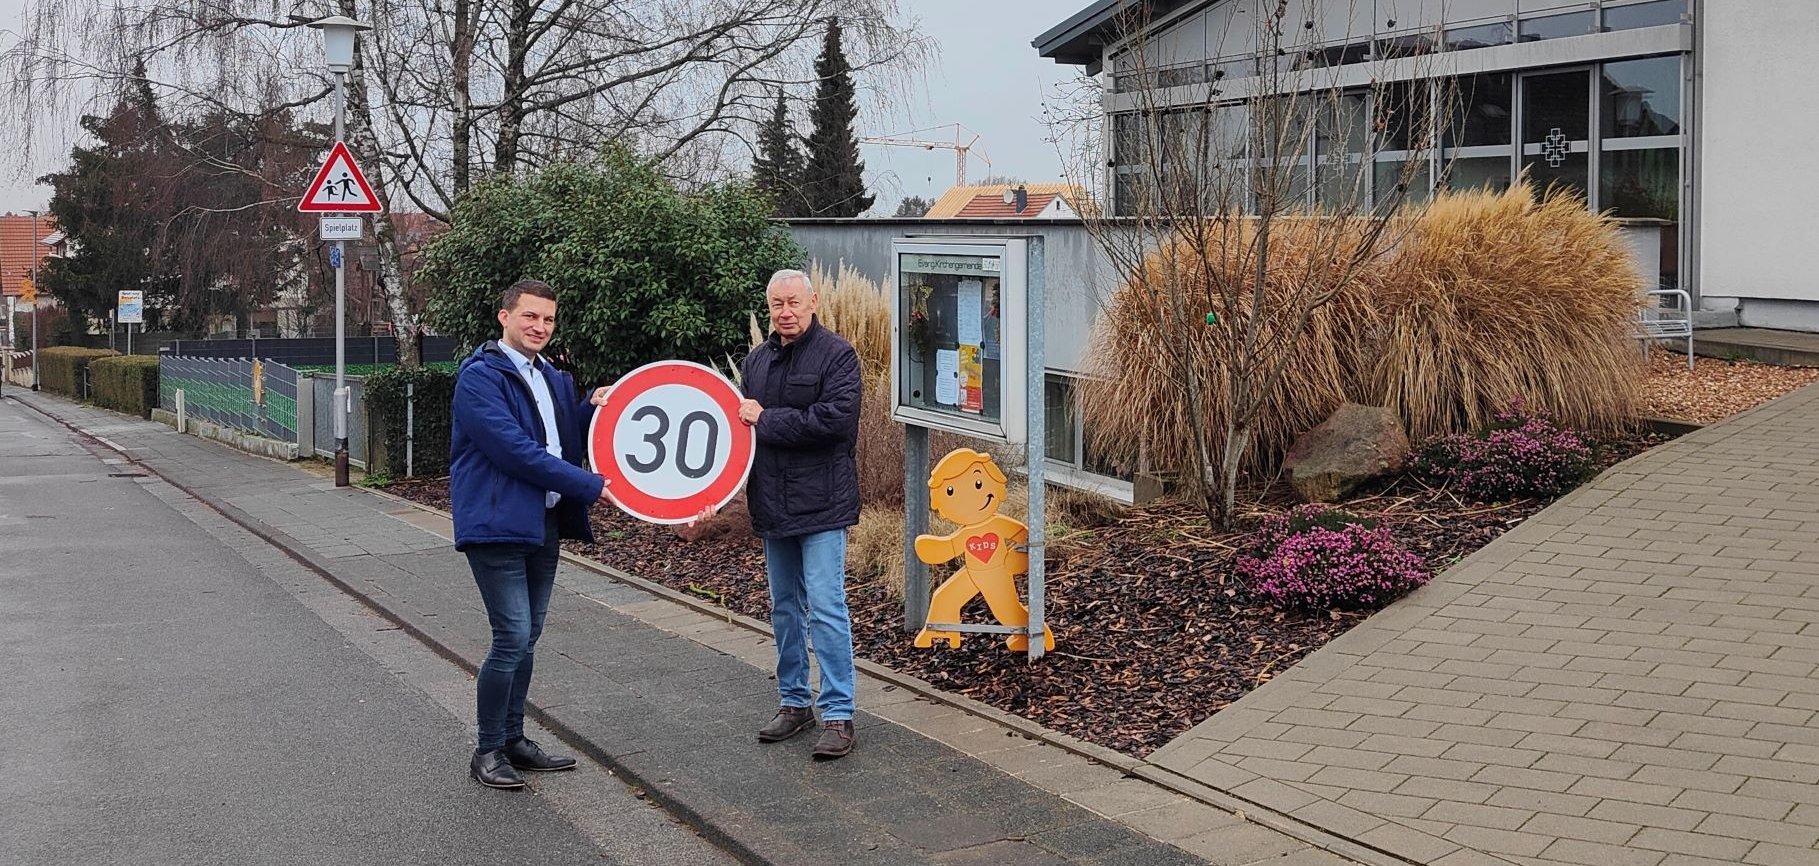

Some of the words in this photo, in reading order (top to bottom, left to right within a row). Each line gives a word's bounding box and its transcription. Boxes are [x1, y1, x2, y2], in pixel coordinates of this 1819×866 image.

[324, 223, 358, 234] Spielplatz
[625, 405, 719, 479] 30
[969, 541, 996, 551] KIDS
